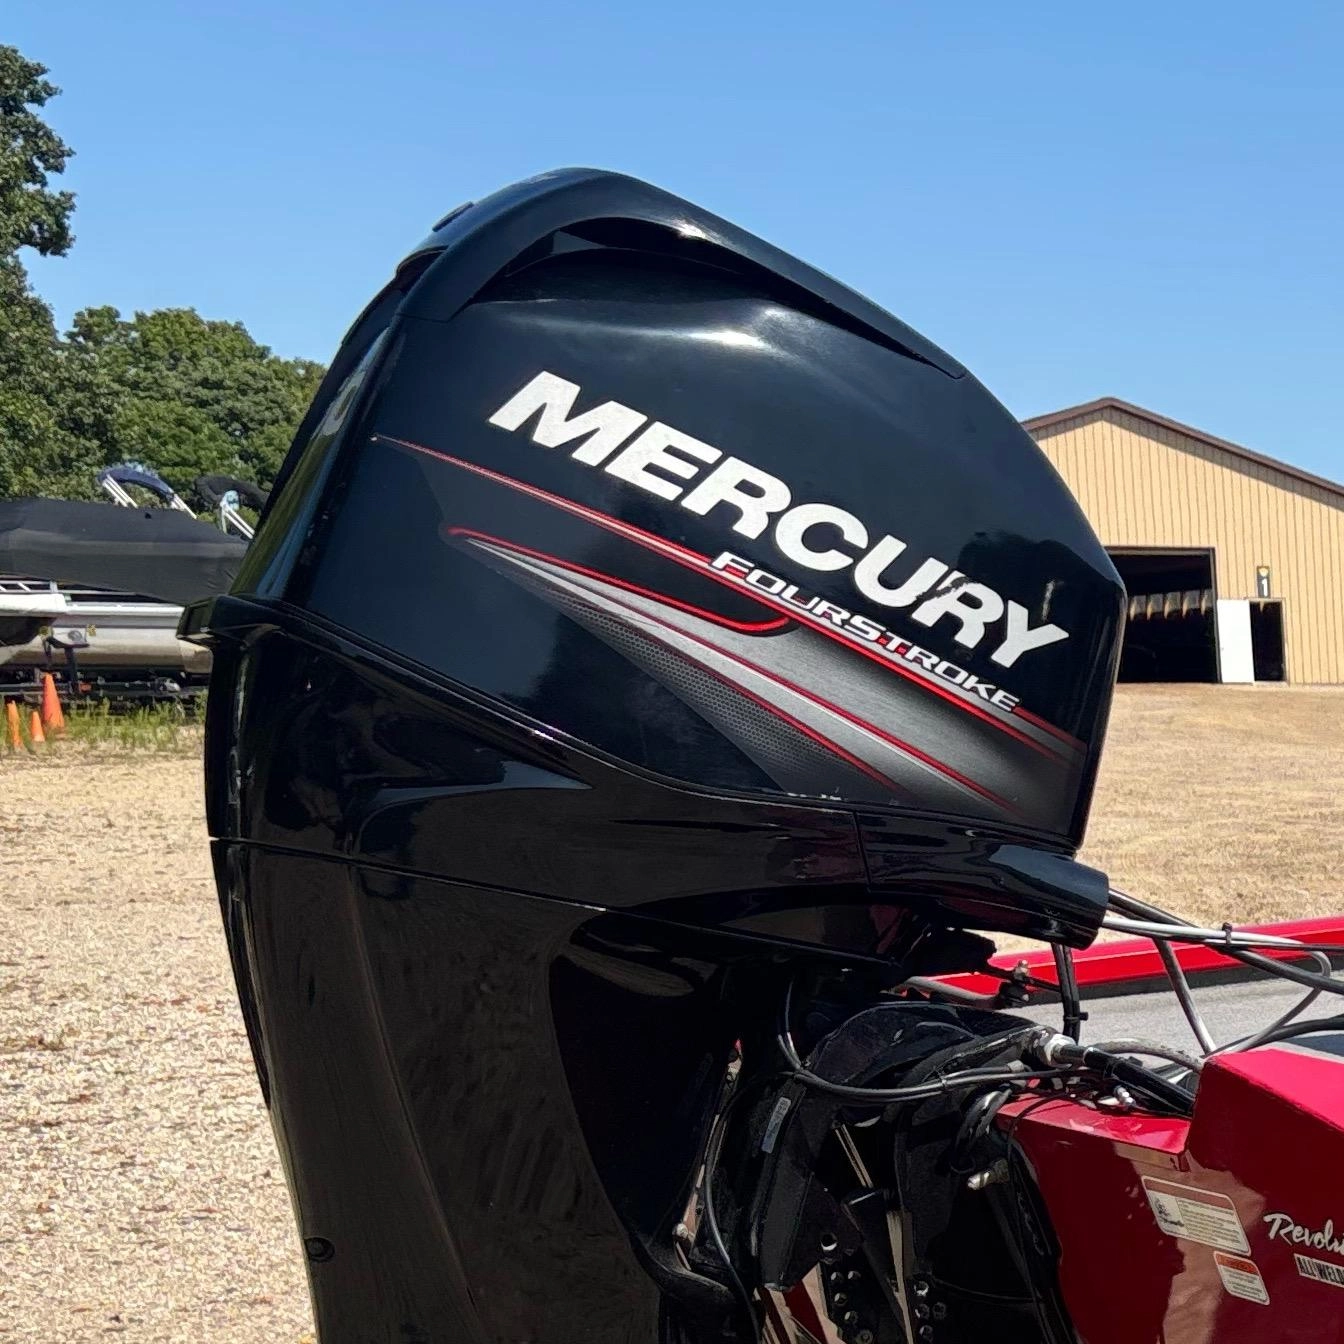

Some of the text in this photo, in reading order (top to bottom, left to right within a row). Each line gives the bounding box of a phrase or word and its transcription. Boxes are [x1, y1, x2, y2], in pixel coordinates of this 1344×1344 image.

[488, 370, 1069, 669] MERCURY
[1261, 578, 1268, 597] 1
[711, 551, 1020, 713] FOURSTROKE
